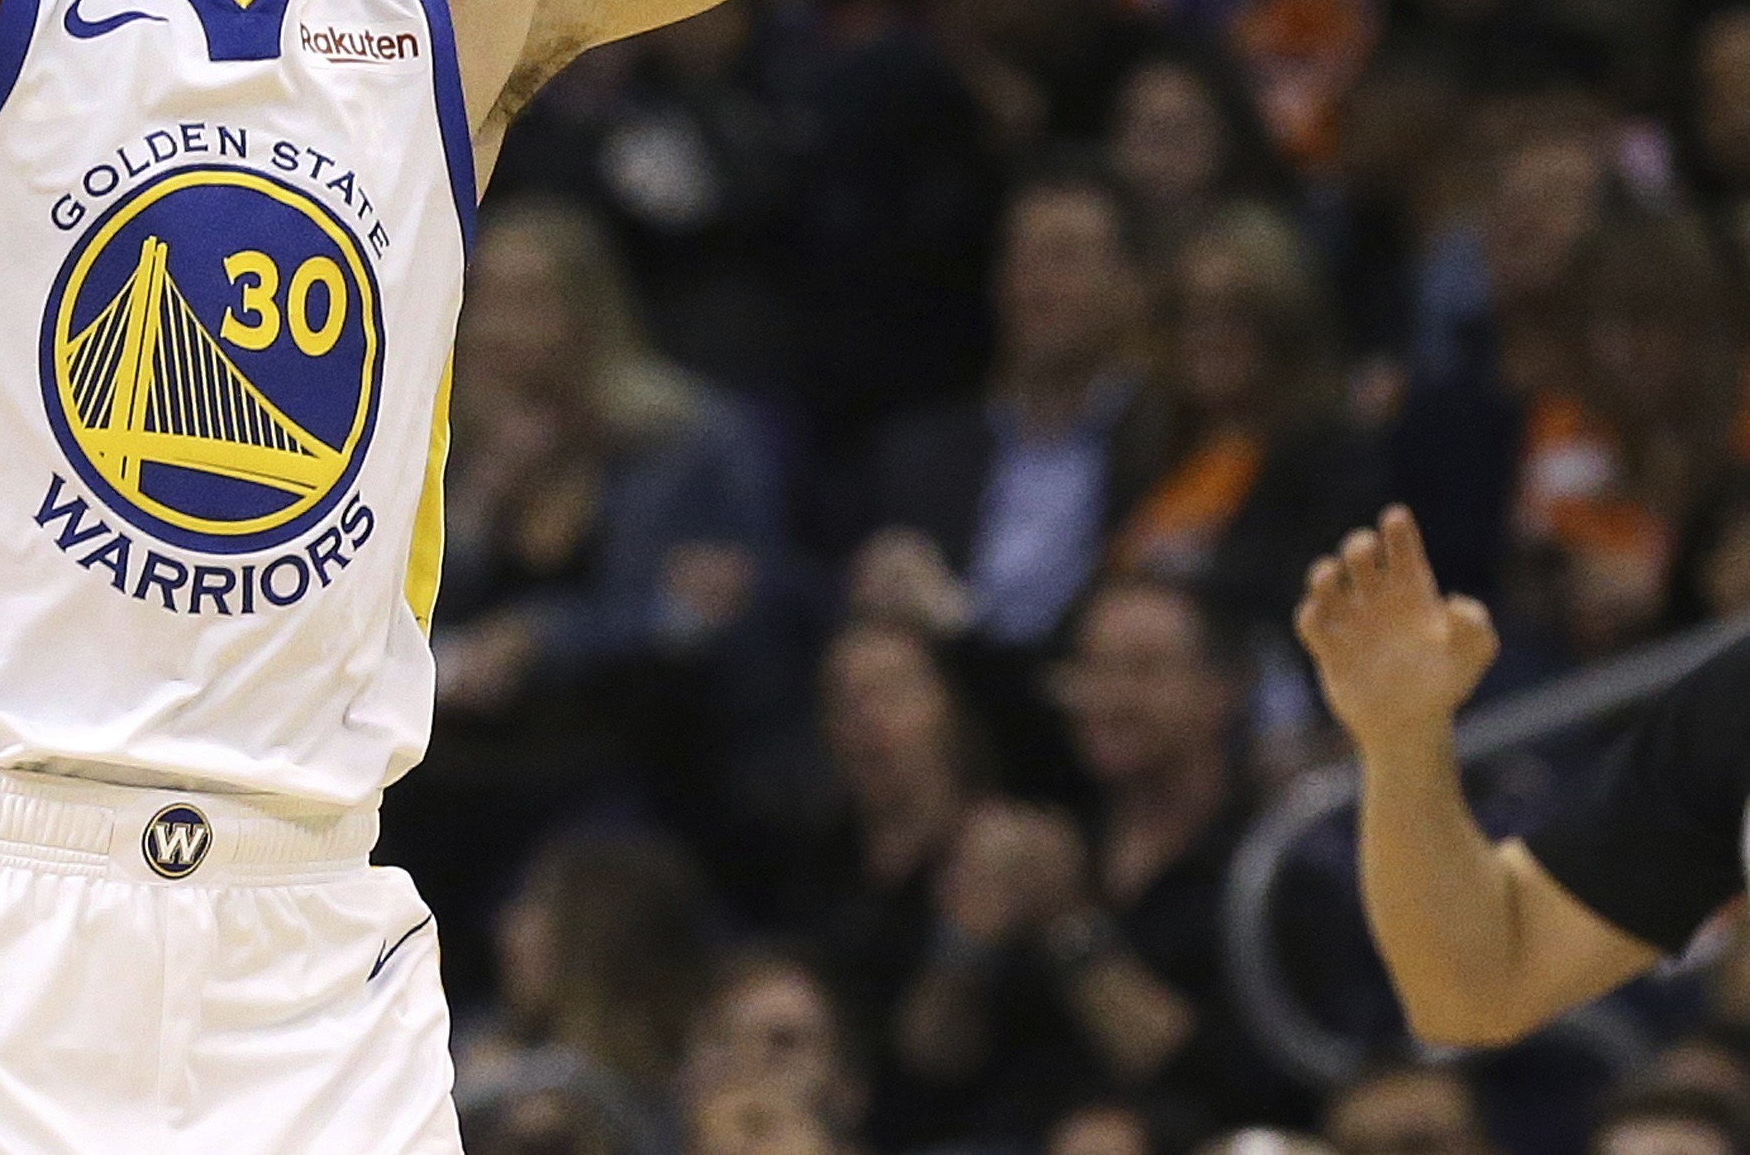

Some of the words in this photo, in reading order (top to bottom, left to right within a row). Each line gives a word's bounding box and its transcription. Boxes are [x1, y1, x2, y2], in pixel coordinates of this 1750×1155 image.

[300, 23, 419, 60] Rakuten
[51, 123, 247, 231] GOLDEN
[271, 141, 391, 260] STATE
[220, 250, 348, 357] 30
[33, 472, 376, 615] WARRIORS
[153, 821, 206, 864] W
